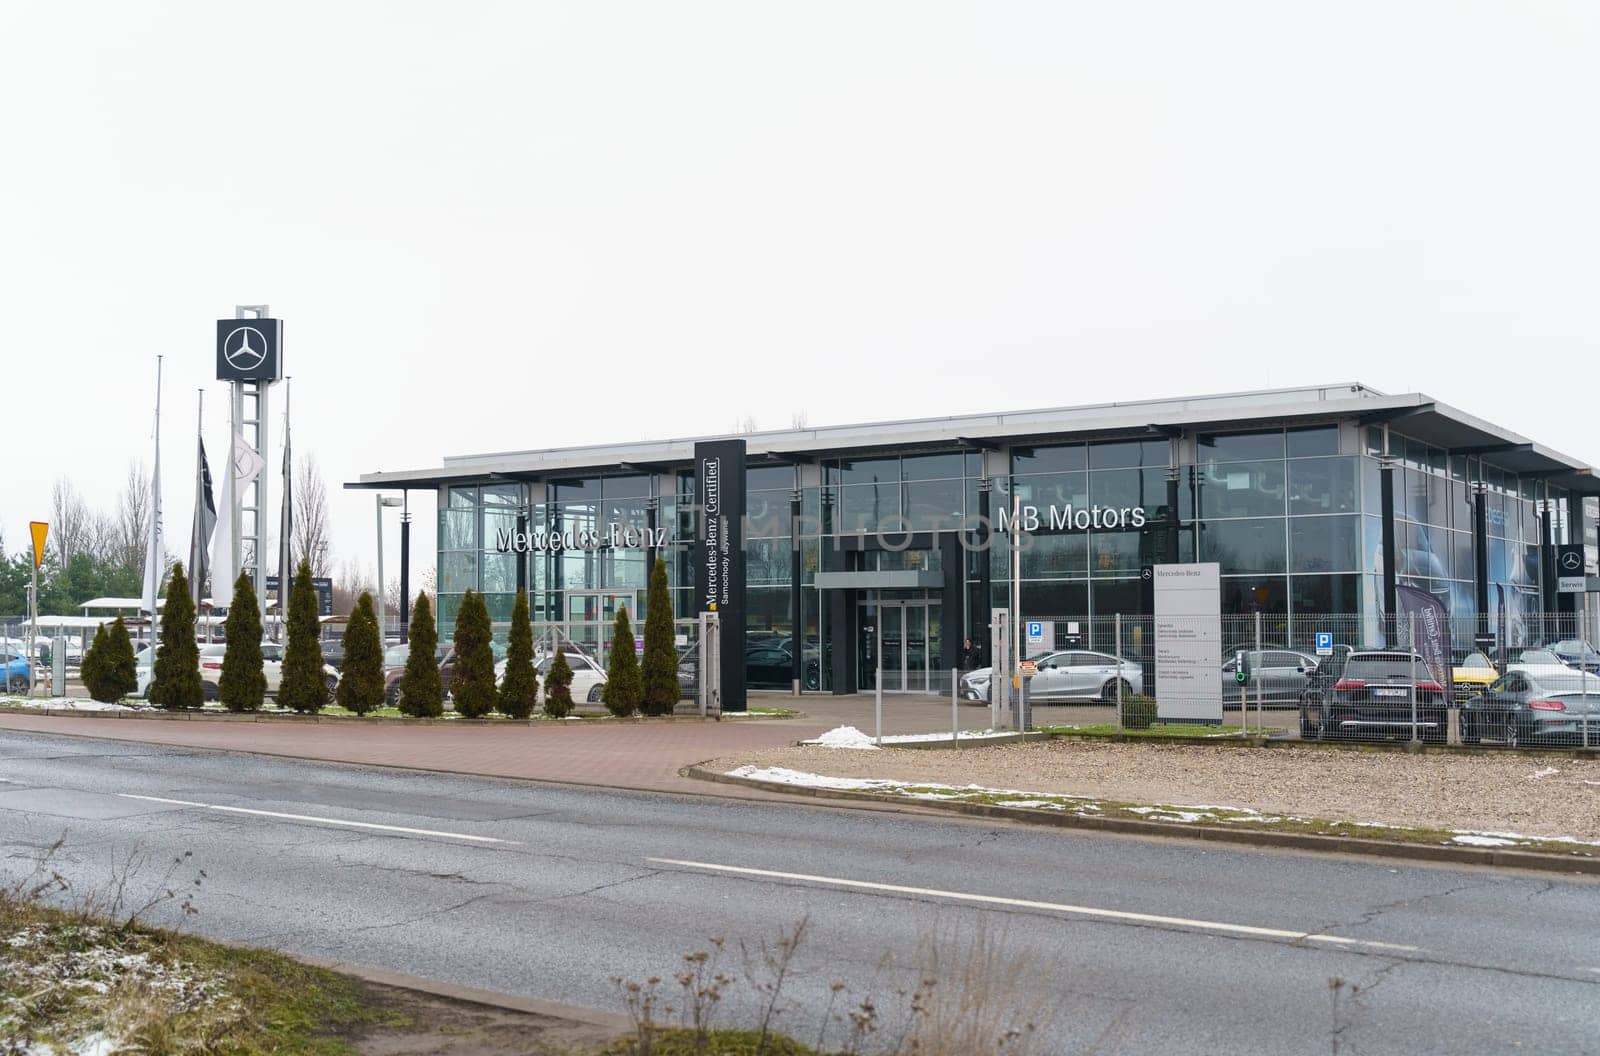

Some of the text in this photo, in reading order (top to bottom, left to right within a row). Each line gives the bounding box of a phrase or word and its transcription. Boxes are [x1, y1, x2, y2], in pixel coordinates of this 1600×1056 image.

[999, 504, 1146, 532] MB Motors
[496, 522, 668, 553] Mercedes-Benz
[705, 461, 718, 605] Mercedes-Benz Certified
[721, 557, 731, 605] Samochody
[1031, 624, 1040, 635] P
[1320, 634, 1329, 647] P
